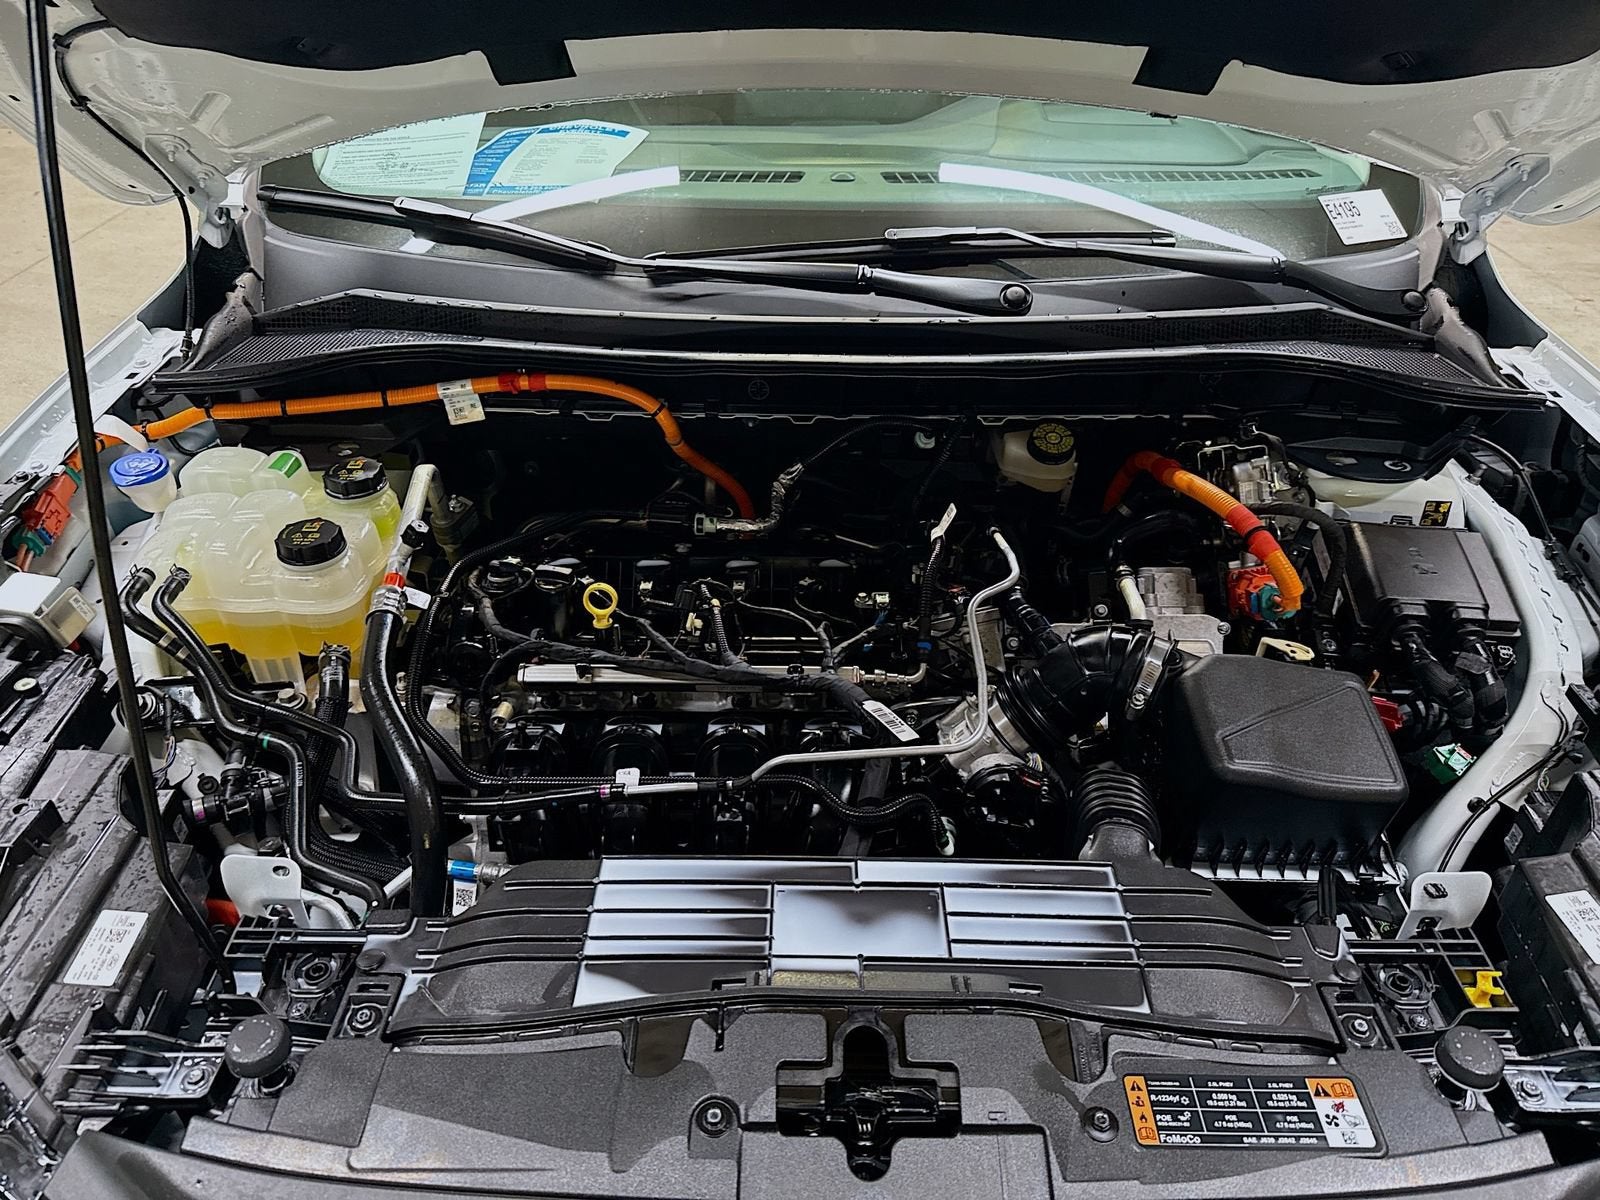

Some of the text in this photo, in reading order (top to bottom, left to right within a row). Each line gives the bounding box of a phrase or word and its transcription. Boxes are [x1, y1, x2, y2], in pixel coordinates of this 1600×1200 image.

[1325, 201, 1361, 219] E4195
[1150, 1094, 1180, 1103] R-1234yf
[1160, 1134, 1201, 1144] FoMoCo
